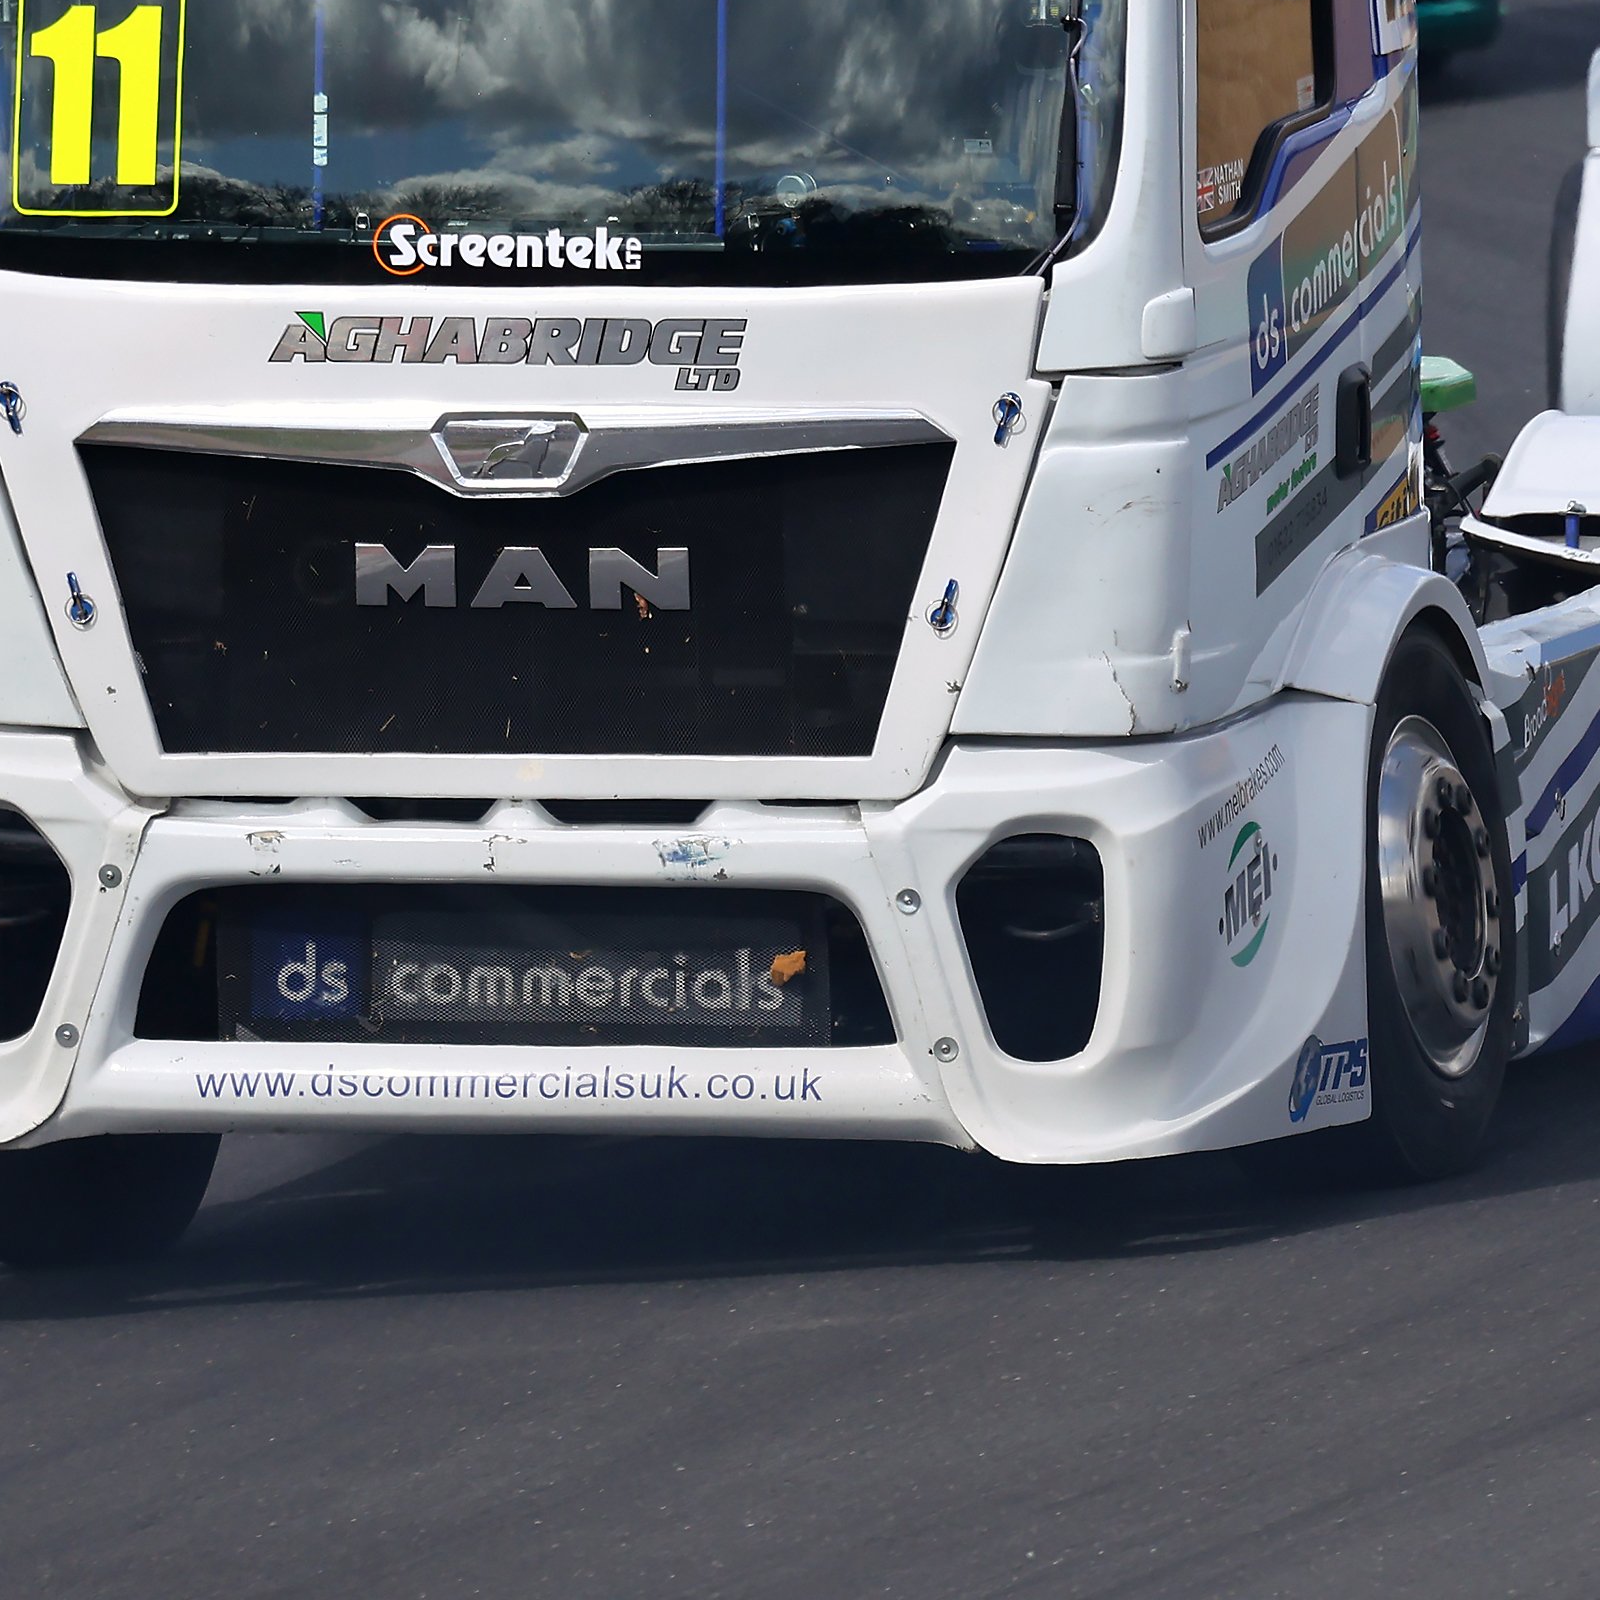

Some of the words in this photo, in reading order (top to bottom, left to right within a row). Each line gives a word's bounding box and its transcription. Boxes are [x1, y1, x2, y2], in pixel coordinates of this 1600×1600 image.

[30, 4, 164, 186] 11
[1213, 159, 1244, 185] NATHAN
[1217, 180, 1242, 206] SMITH
[388, 224, 625, 271] Screentek
[624, 236, 642, 270] LTD
[1255, 293, 1280, 370] ds
[1290, 159, 1398, 333] commercials
[266, 311, 749, 366] AGHABRIDGE
[674, 366, 742, 392] LTD
[355, 542, 691, 611] MAN
[1197, 742, 1286, 850] www.meibrakes.com
[1224, 841, 1274, 946] MEI
[276, 939, 350, 1004] ds
[384, 947, 787, 1012] commercials
[195, 1064, 823, 1100] www.dscommercialsuk.co.uk
[1315, 1092, 1337, 1106] GLOBAL
[1338, 1089, 1365, 1103] LOGISTICS
